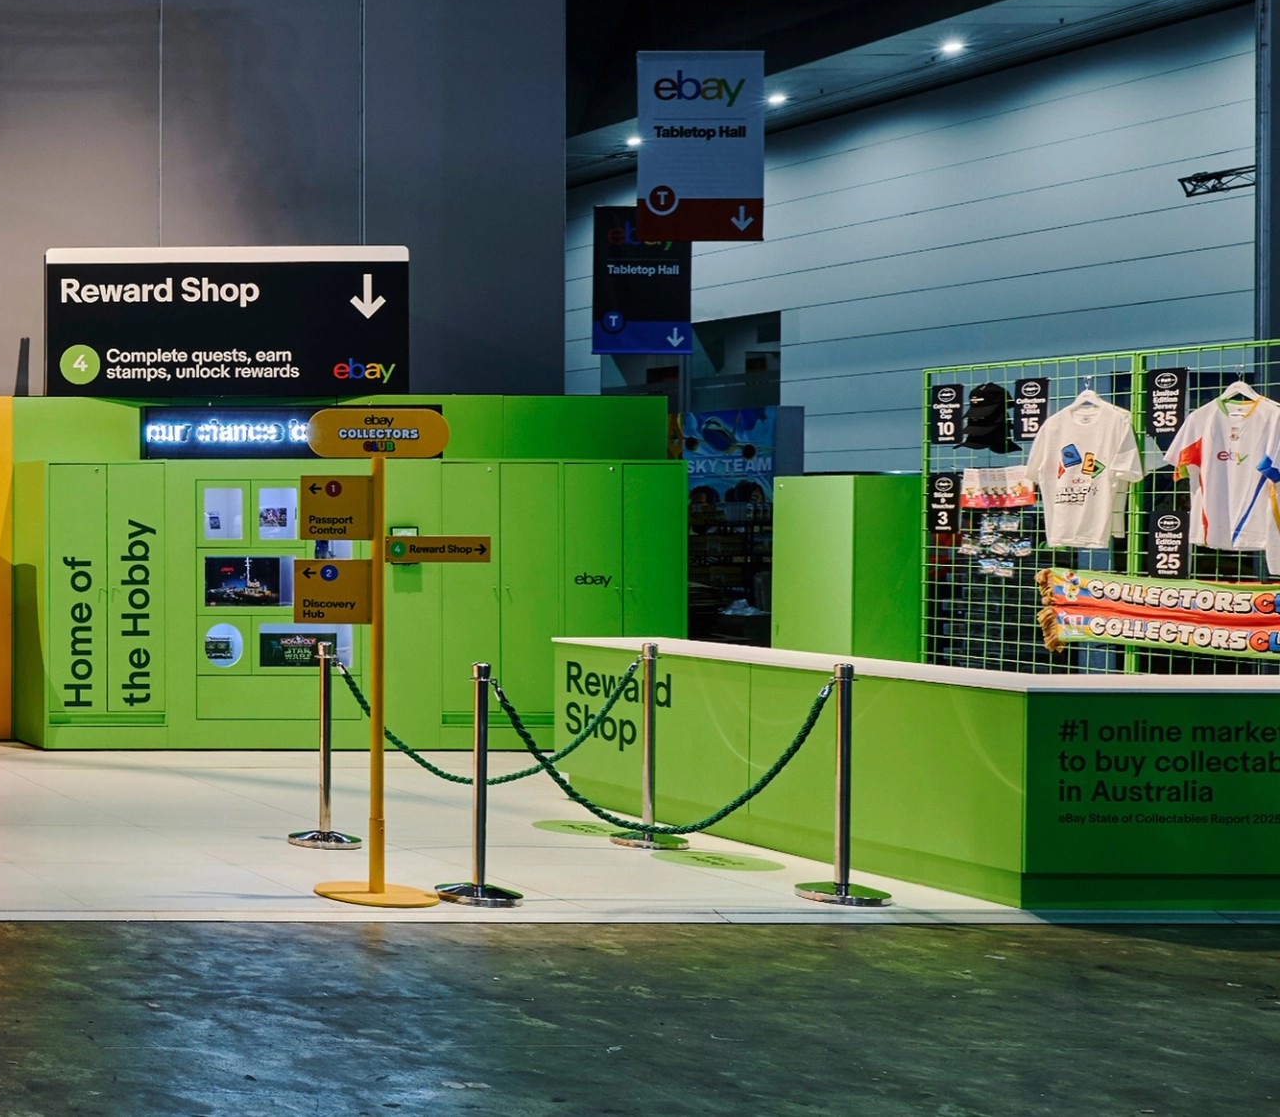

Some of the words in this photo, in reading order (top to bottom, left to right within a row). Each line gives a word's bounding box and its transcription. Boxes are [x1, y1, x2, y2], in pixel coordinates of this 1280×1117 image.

[654, 70, 746, 107] ebay
[654, 126, 716, 140] Tabletop
[719, 125, 746, 138] Hall
[656, 191, 669, 205] T
[607, 264, 656, 276] Tabletop
[658, 264, 680, 275] Hall
[60, 277, 173, 303] Reward
[181, 277, 260, 308] Shop
[72, 354, 88, 372] 4
[106, 348, 188, 364] Complete
[191, 349, 252, 365] quests,
[255, 350, 292, 362] earn
[106, 366, 172, 381] stamps,
[176, 363, 230, 379] unlock
[234, 363, 300, 379] rewards
[333, 358, 395, 383] ebay
[1152, 389, 1180, 397] Limited
[364, 414, 394, 427] ebay
[1021, 417, 1039, 432] 15
[1152, 411, 1178, 427] 35
[338, 428, 419, 439] COLLECTORS
[937, 421, 955, 436] 10
[363, 440, 395, 453] CLUB
[686, 458, 719, 474] SKY
[723, 457, 772, 472] TEAM
[309, 515, 353, 526] Passport
[938, 511, 949, 525] 3
[309, 526, 347, 535] Control
[409, 544, 445, 554] Reward
[447, 544, 473, 556] Shop
[1156, 553, 1181, 569] 25
[63, 556, 93, 593] of
[120, 519, 157, 636] Hobby
[574, 572, 613, 588] ebay
[302, 599, 356, 610] Discovery
[302, 610, 325, 619] Hub
[1089, 615, 1249, 651] COLLECTORS
[64, 602, 93, 707] Home
[122, 648, 151, 707] the
[566, 660, 672, 708] Rewad
[1058, 719, 1089, 743] #1
[1098, 719, 1182, 743] online
[1191, 720, 1280, 743] marke
[1058, 750, 1086, 773] to
[1095, 750, 1146, 777] buy
[1058, 780, 1082, 802] in
[1091, 780, 1213, 802] Australia
[1058, 813, 1087, 826] eBay
[1089, 813, 1119, 824] State
[1121, 813, 1133, 824] of
[1135, 813, 1208, 824] Collectables
[1211, 814, 1250, 826] Report
